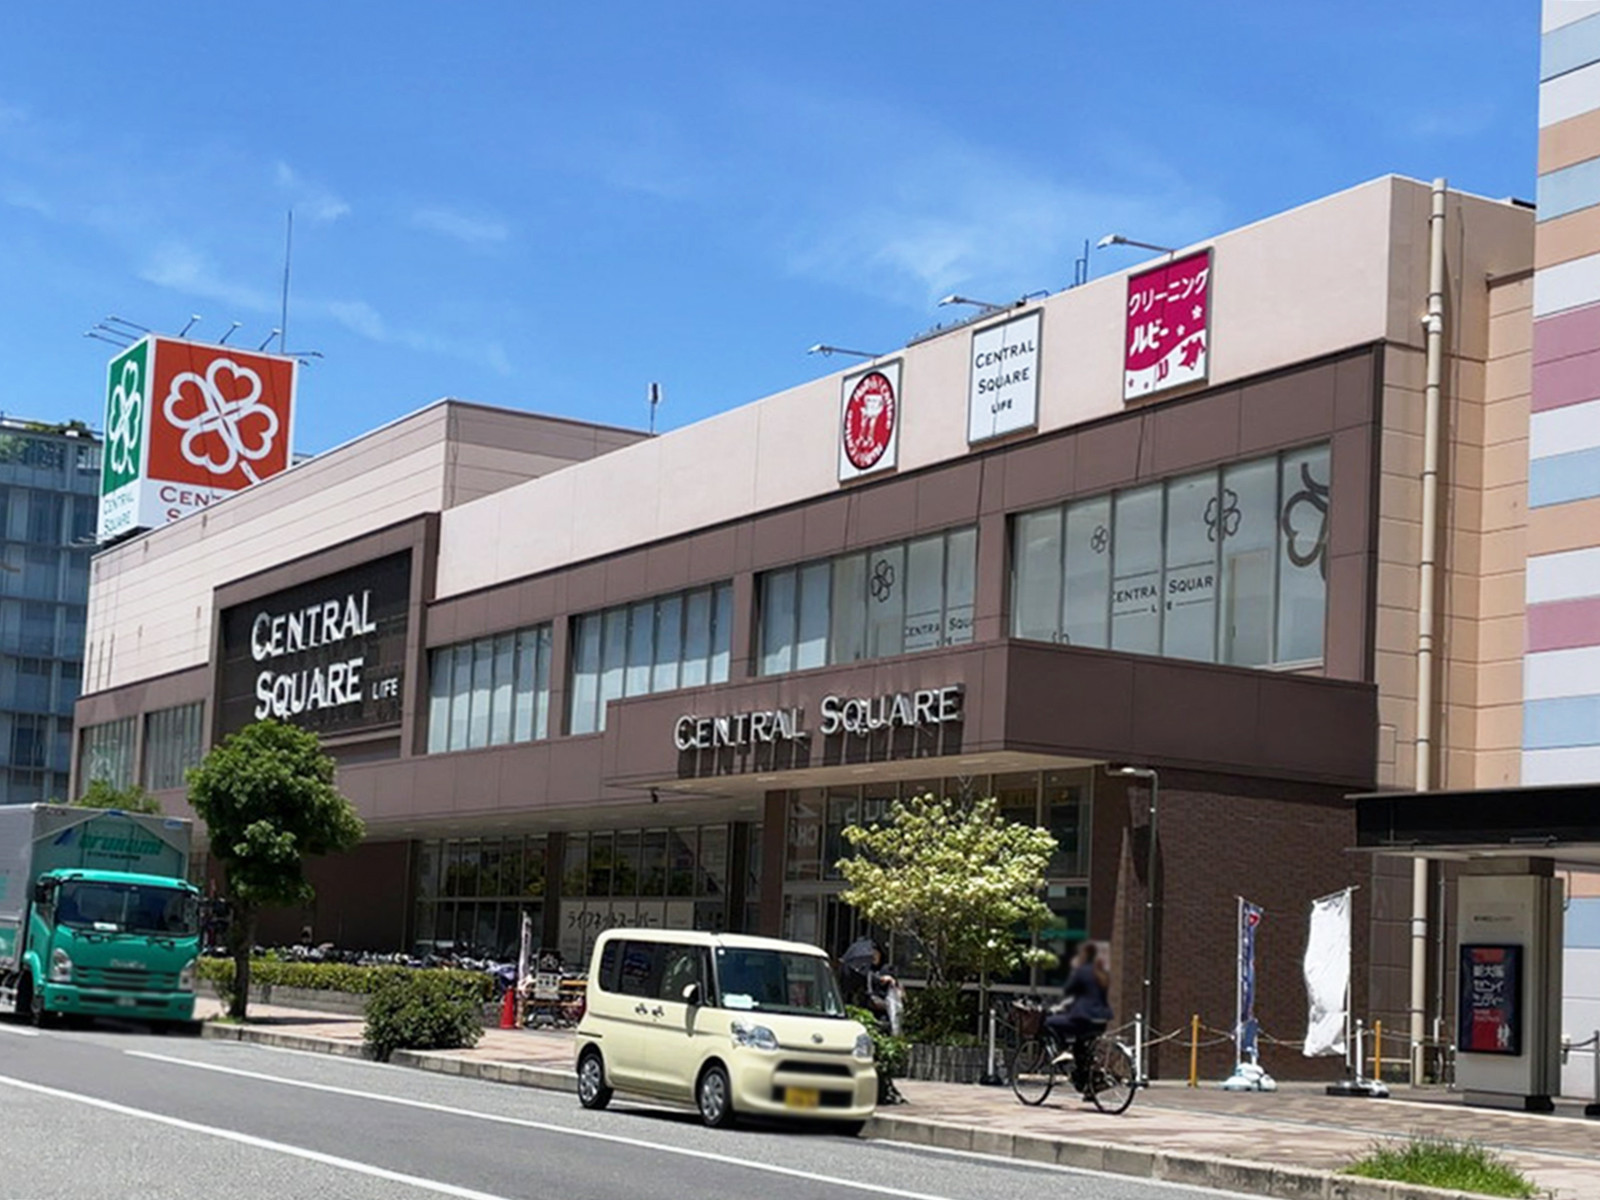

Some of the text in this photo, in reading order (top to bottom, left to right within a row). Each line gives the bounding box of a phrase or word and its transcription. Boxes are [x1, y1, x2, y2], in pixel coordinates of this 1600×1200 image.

[1129, 268, 1209, 317] クリーニング
[975, 340, 1035, 369] CENTRAL
[1129, 319, 1169, 357] ルビー
[978, 367, 1030, 394] SQUARE
[991, 398, 1013, 414] LIFE
[251, 590, 376, 661] CENTRAL
[254, 657, 399, 720] SQUARE LIFE
[674, 685, 962, 750] CENTRAL SQUARE
